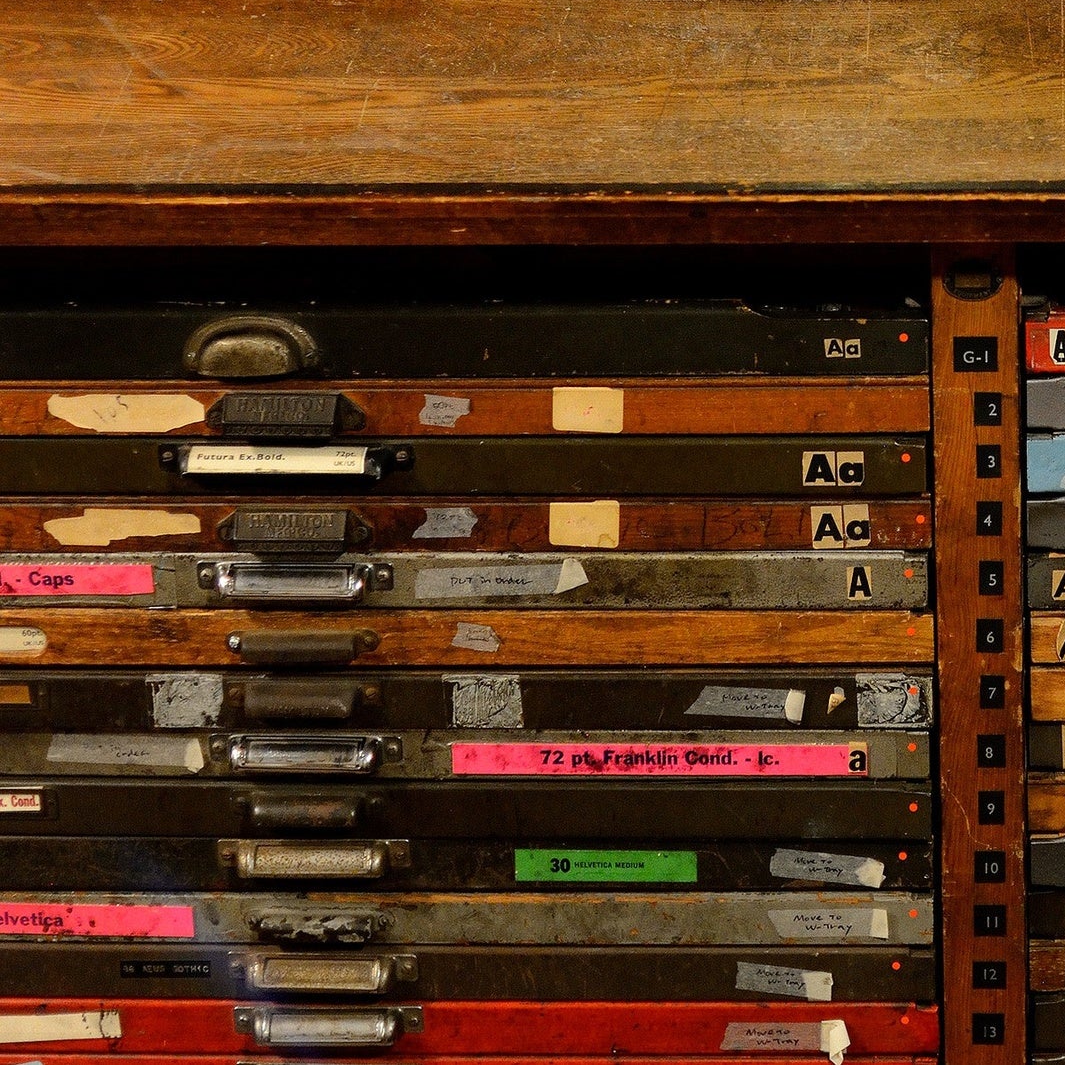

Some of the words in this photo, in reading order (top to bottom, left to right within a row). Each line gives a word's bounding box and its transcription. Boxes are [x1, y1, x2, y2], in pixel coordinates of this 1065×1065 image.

[826, 339, 859, 356] Aa
[988, 403, 998, 416] 2
[196, 453, 235, 461] Futura
[987, 455, 996, 467] 3
[804, 454, 864, 483] Aa
[983, 514, 993, 526] 4
[813, 514, 871, 542] Aa
[28, 570, 75, 590] Caps
[849, 566, 872, 598] A
[988, 574, 997, 586] 5
[986, 631, 995, 644] 6
[987, 687, 997, 699] 7
[540, 750, 564, 765] 72
[603, 749, 679, 766] Franklin
[685, 749, 738, 766] Cond.
[985, 747, 994, 759] 8
[849, 749, 868, 772] a
[11, 795, 39, 808] Cond.
[987, 803, 996, 815] 9
[549, 857, 571, 873] 30
[574, 861, 613, 869] HELVETICA
[983, 862, 999, 874] 10
[793, 914, 823, 922] Move
[985, 916, 999, 928] 11
[982, 969, 998, 981] 12
[982, 1026, 997, 1039] 13
